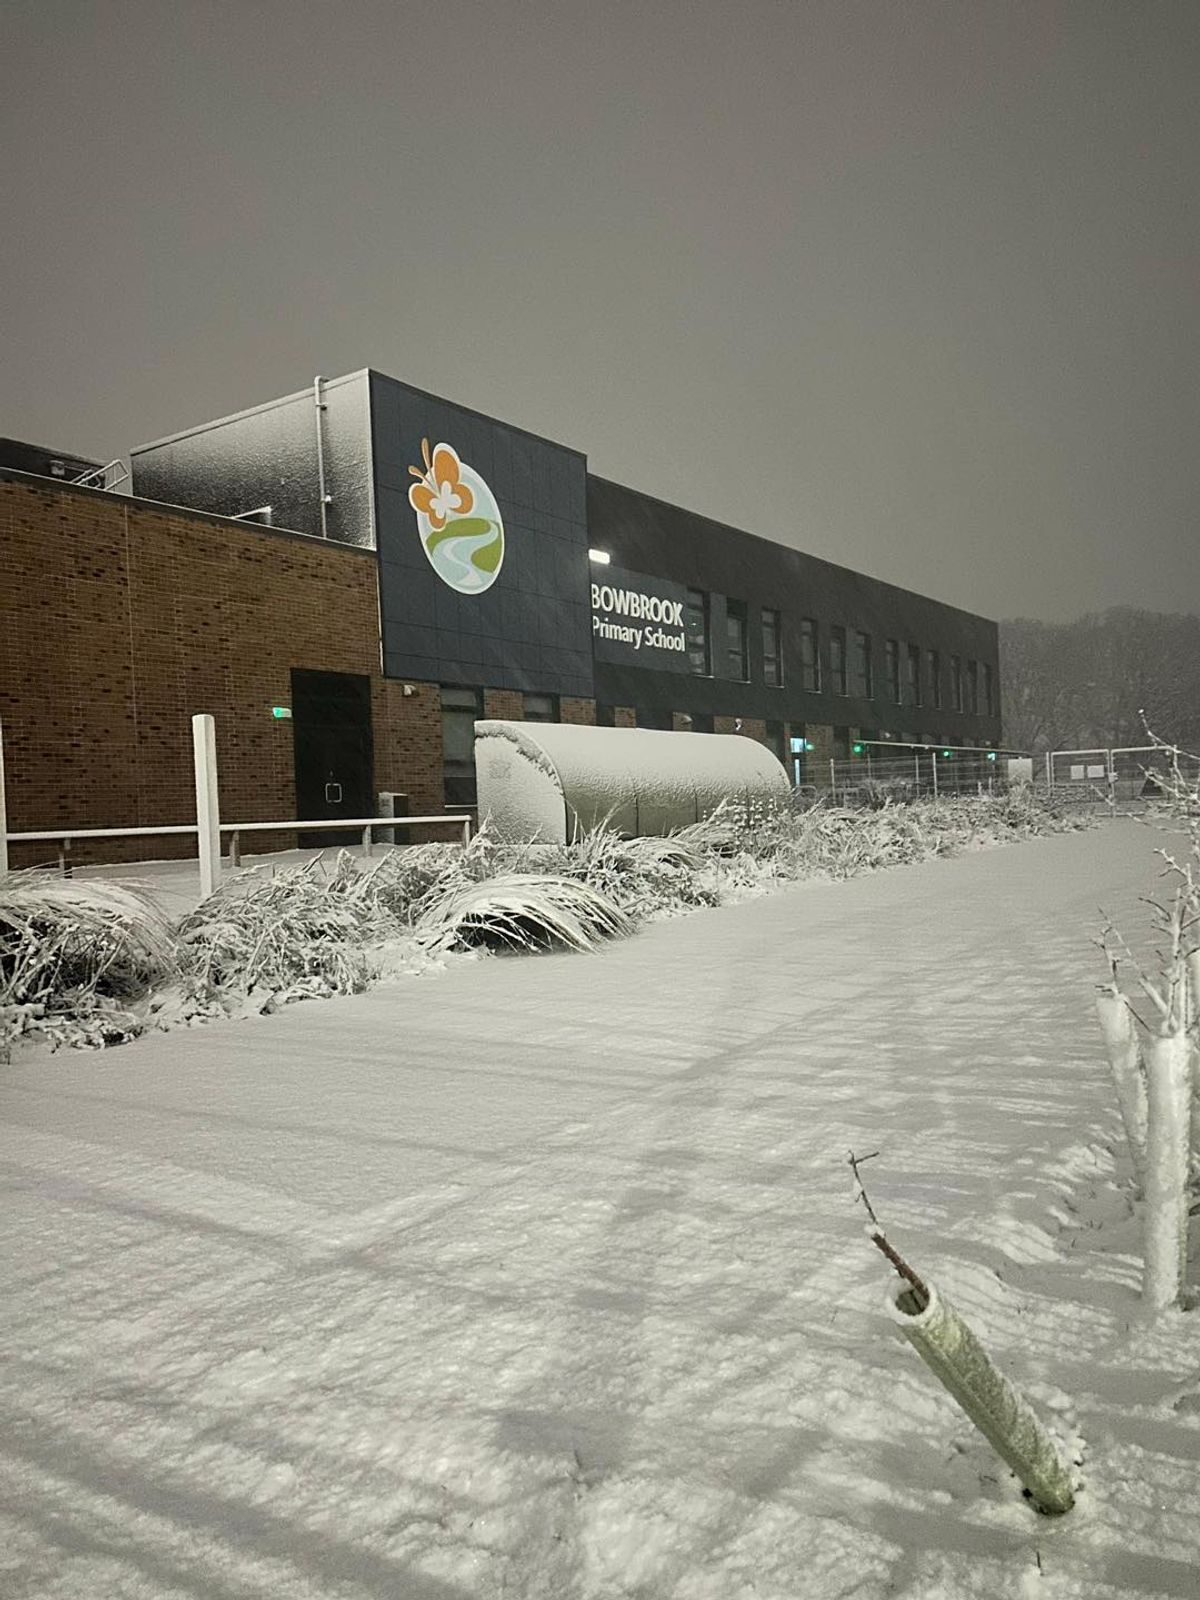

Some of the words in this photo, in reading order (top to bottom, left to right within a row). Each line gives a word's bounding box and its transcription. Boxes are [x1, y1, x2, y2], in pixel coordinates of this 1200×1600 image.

[591, 583, 684, 627] BOWBROOK
[592, 615, 642, 650] Primary
[644, 626, 685, 652] School
